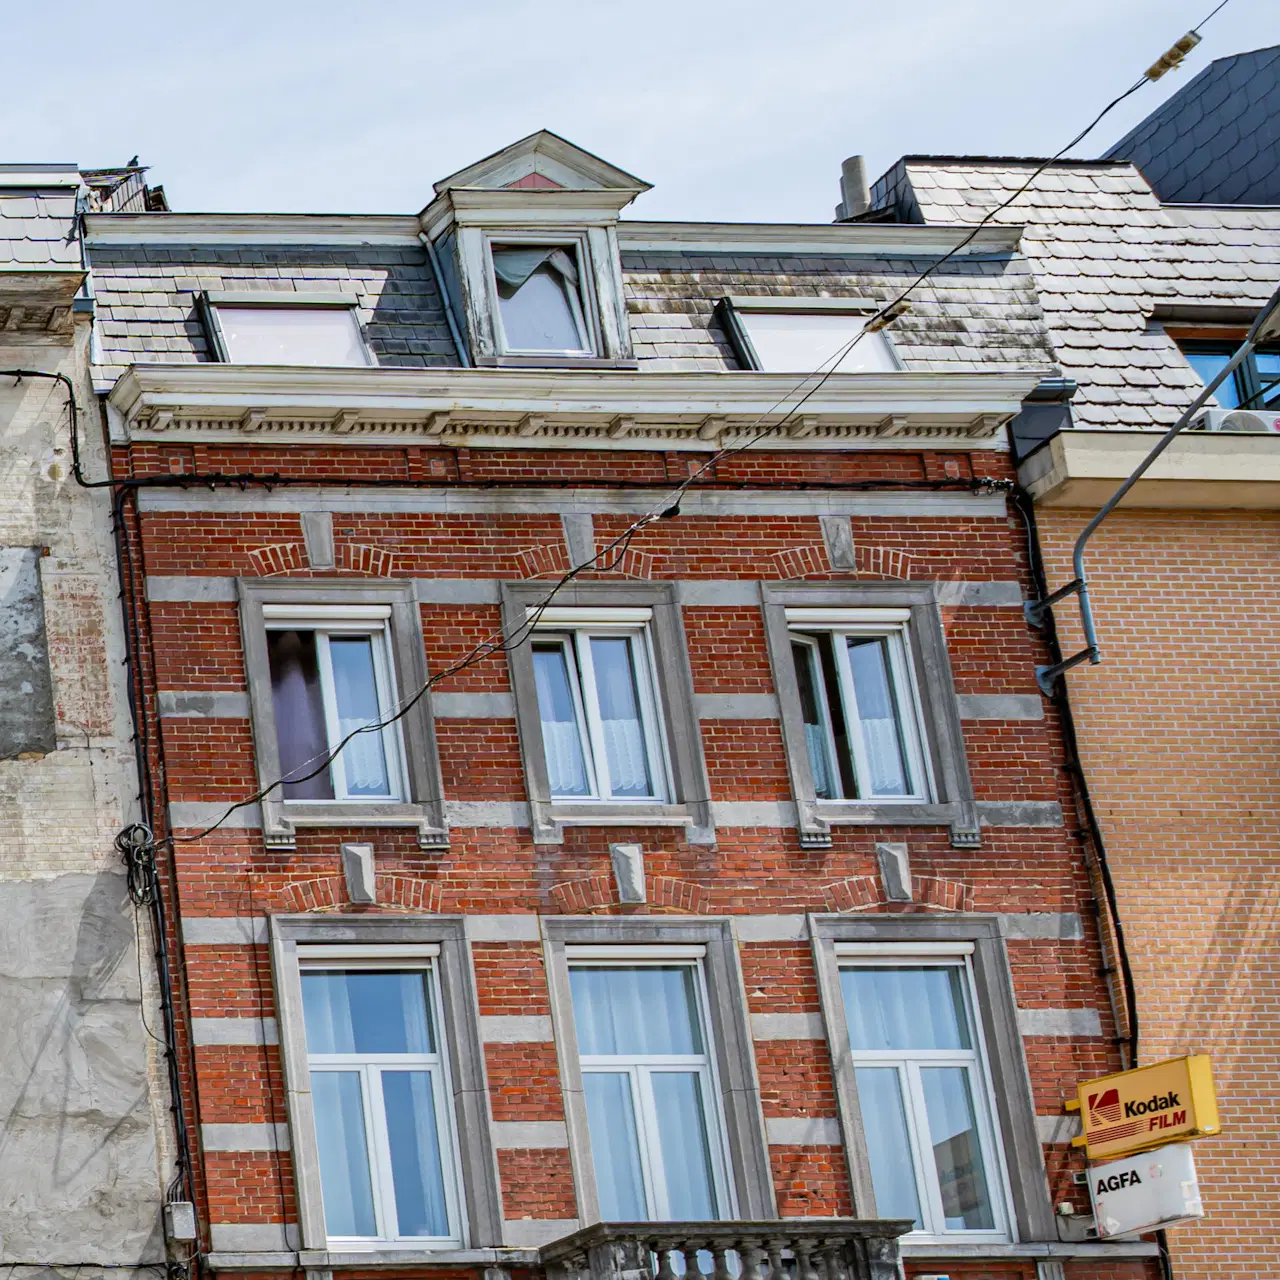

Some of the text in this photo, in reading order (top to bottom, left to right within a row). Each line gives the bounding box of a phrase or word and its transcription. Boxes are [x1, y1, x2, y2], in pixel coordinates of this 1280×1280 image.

[1124, 1091, 1181, 1118] Kodak
[1148, 1109, 1187, 1132] FILM
[1096, 1169, 1142, 1196] AGFA
